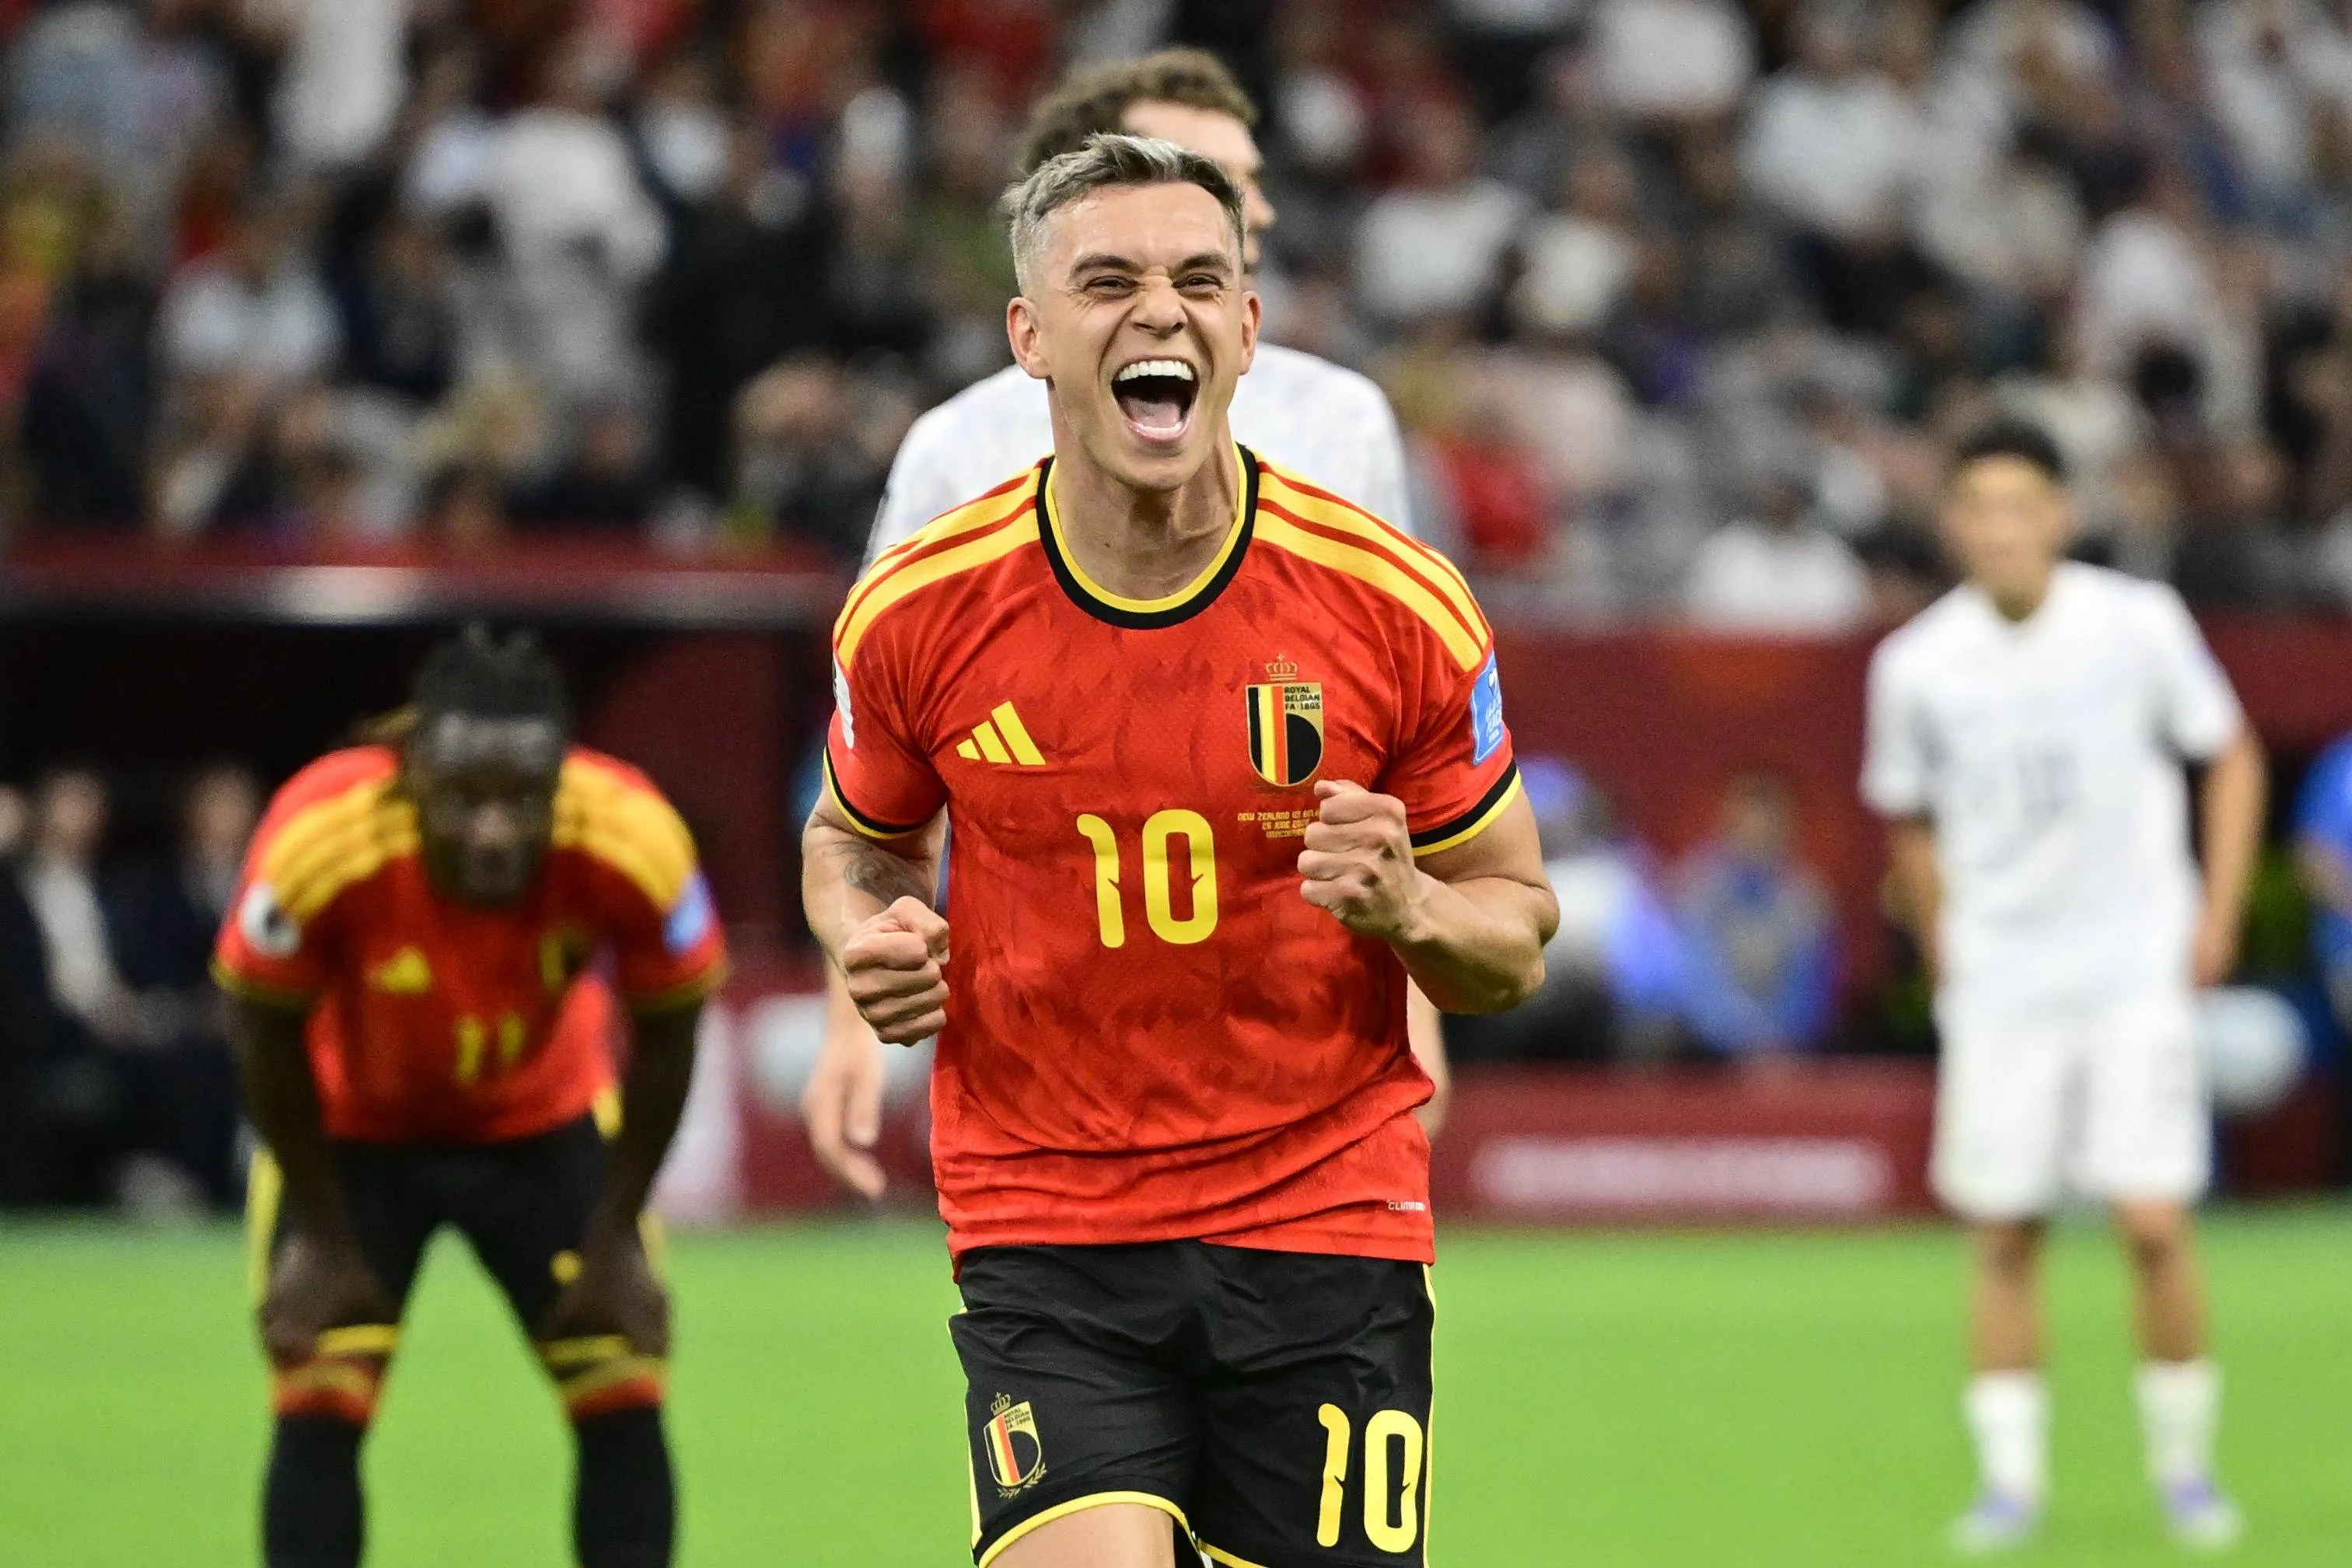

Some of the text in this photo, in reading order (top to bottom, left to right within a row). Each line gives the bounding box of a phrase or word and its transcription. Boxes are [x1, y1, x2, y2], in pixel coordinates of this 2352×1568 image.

[1284, 693, 1320, 702] BELGIAN
[1076, 808, 1218, 948] 10
[1316, 1402, 1424, 1552] 10
